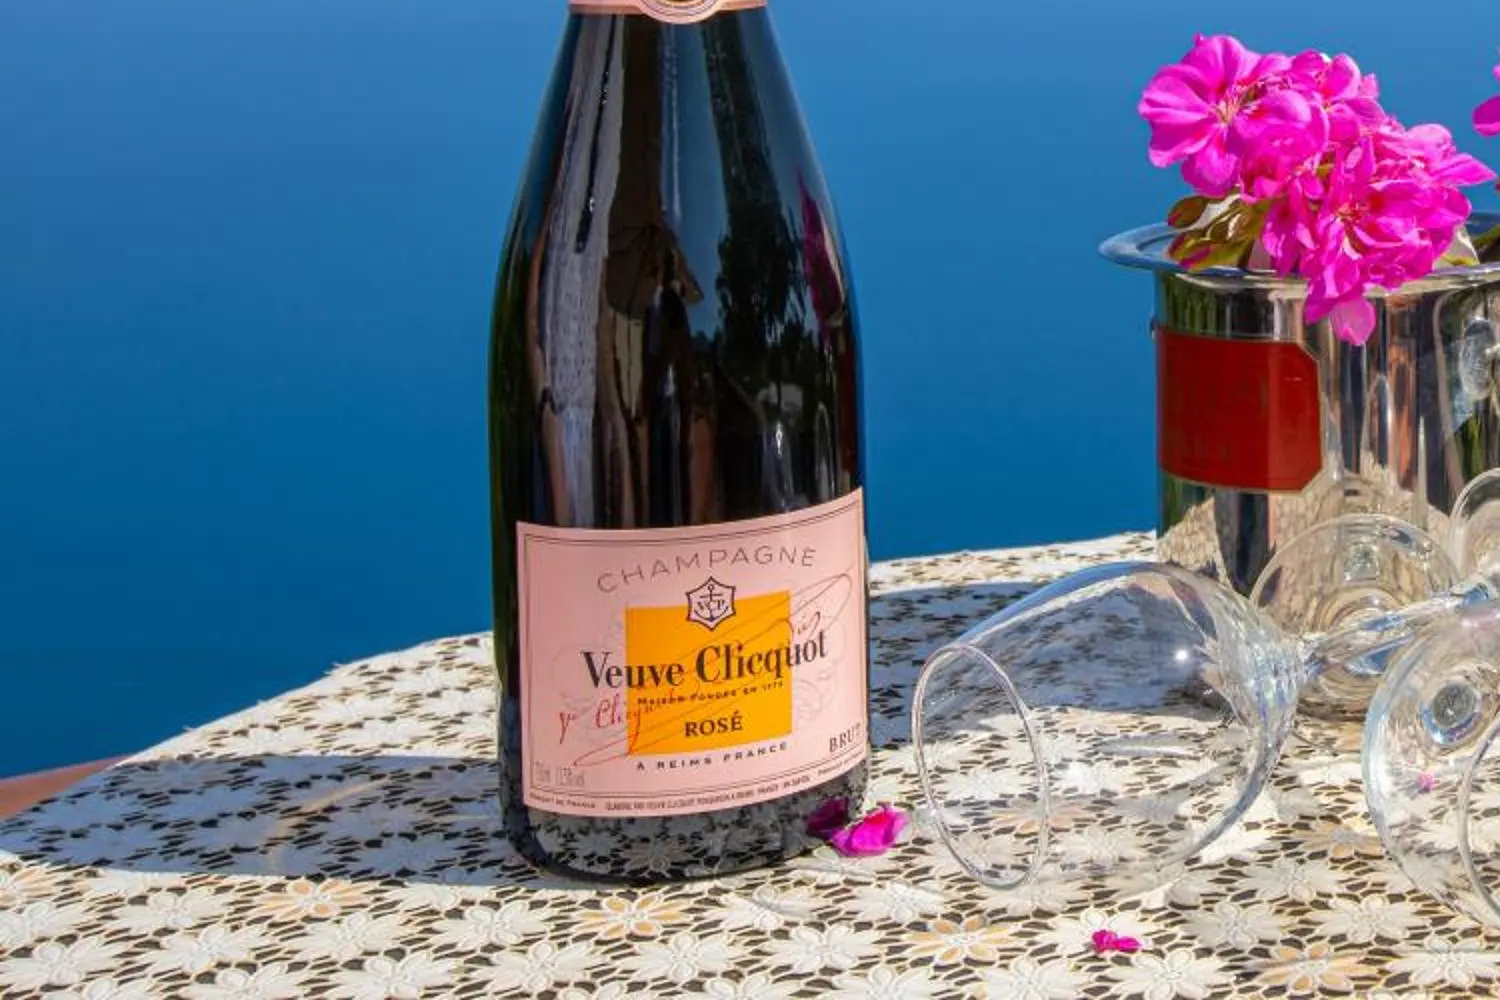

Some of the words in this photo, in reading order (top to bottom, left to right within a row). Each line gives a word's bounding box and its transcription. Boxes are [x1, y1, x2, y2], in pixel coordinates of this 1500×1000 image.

[596, 545, 817, 594] CHAMPAGNE
[582, 650, 685, 690] Veuve
[695, 630, 827, 684] Clicquot
[684, 710, 744, 738] ROSÉ
[636, 761, 645, 771] A
[657, 756, 712, 770] REIMS
[723, 741, 787, 762] FRANCE
